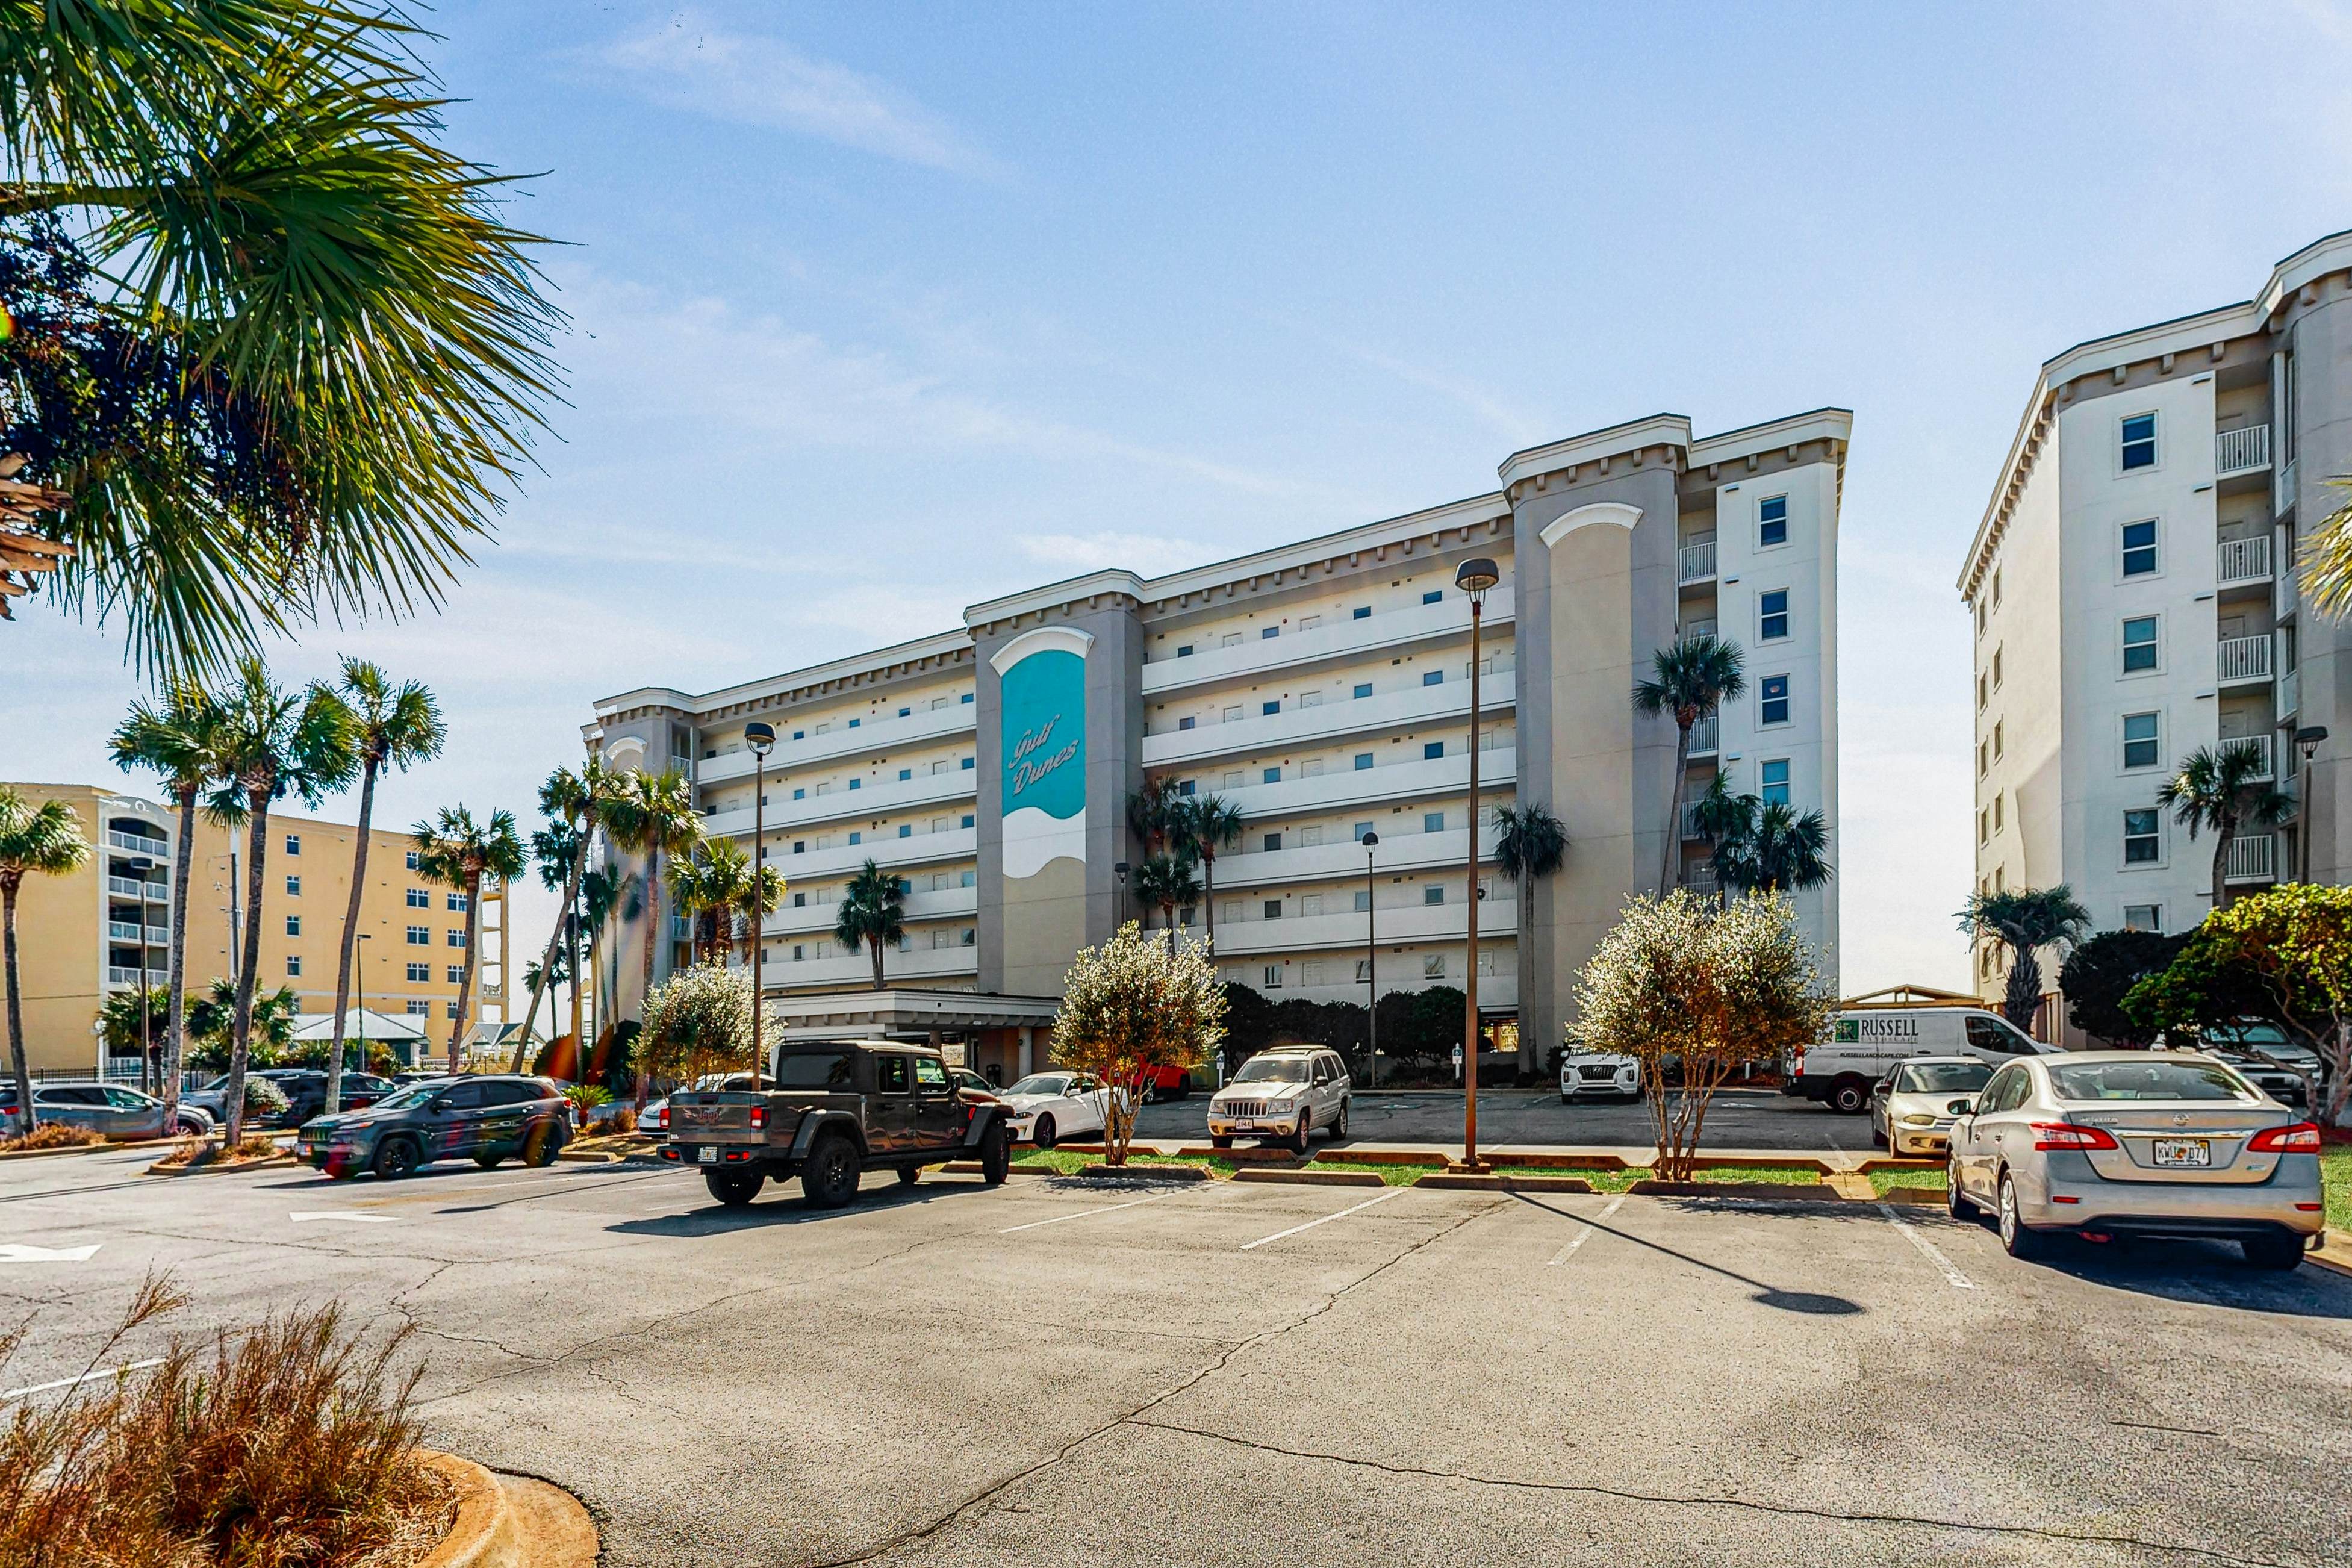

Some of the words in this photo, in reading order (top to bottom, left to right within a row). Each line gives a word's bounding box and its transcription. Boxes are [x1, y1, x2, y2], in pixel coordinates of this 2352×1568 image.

[1008, 713, 1060, 769] Gulf
[1012, 739, 1079, 797] Dunes
[1861, 1019, 1919, 1036] RUSSELL
[698, 1108, 719, 1124] Jeep
